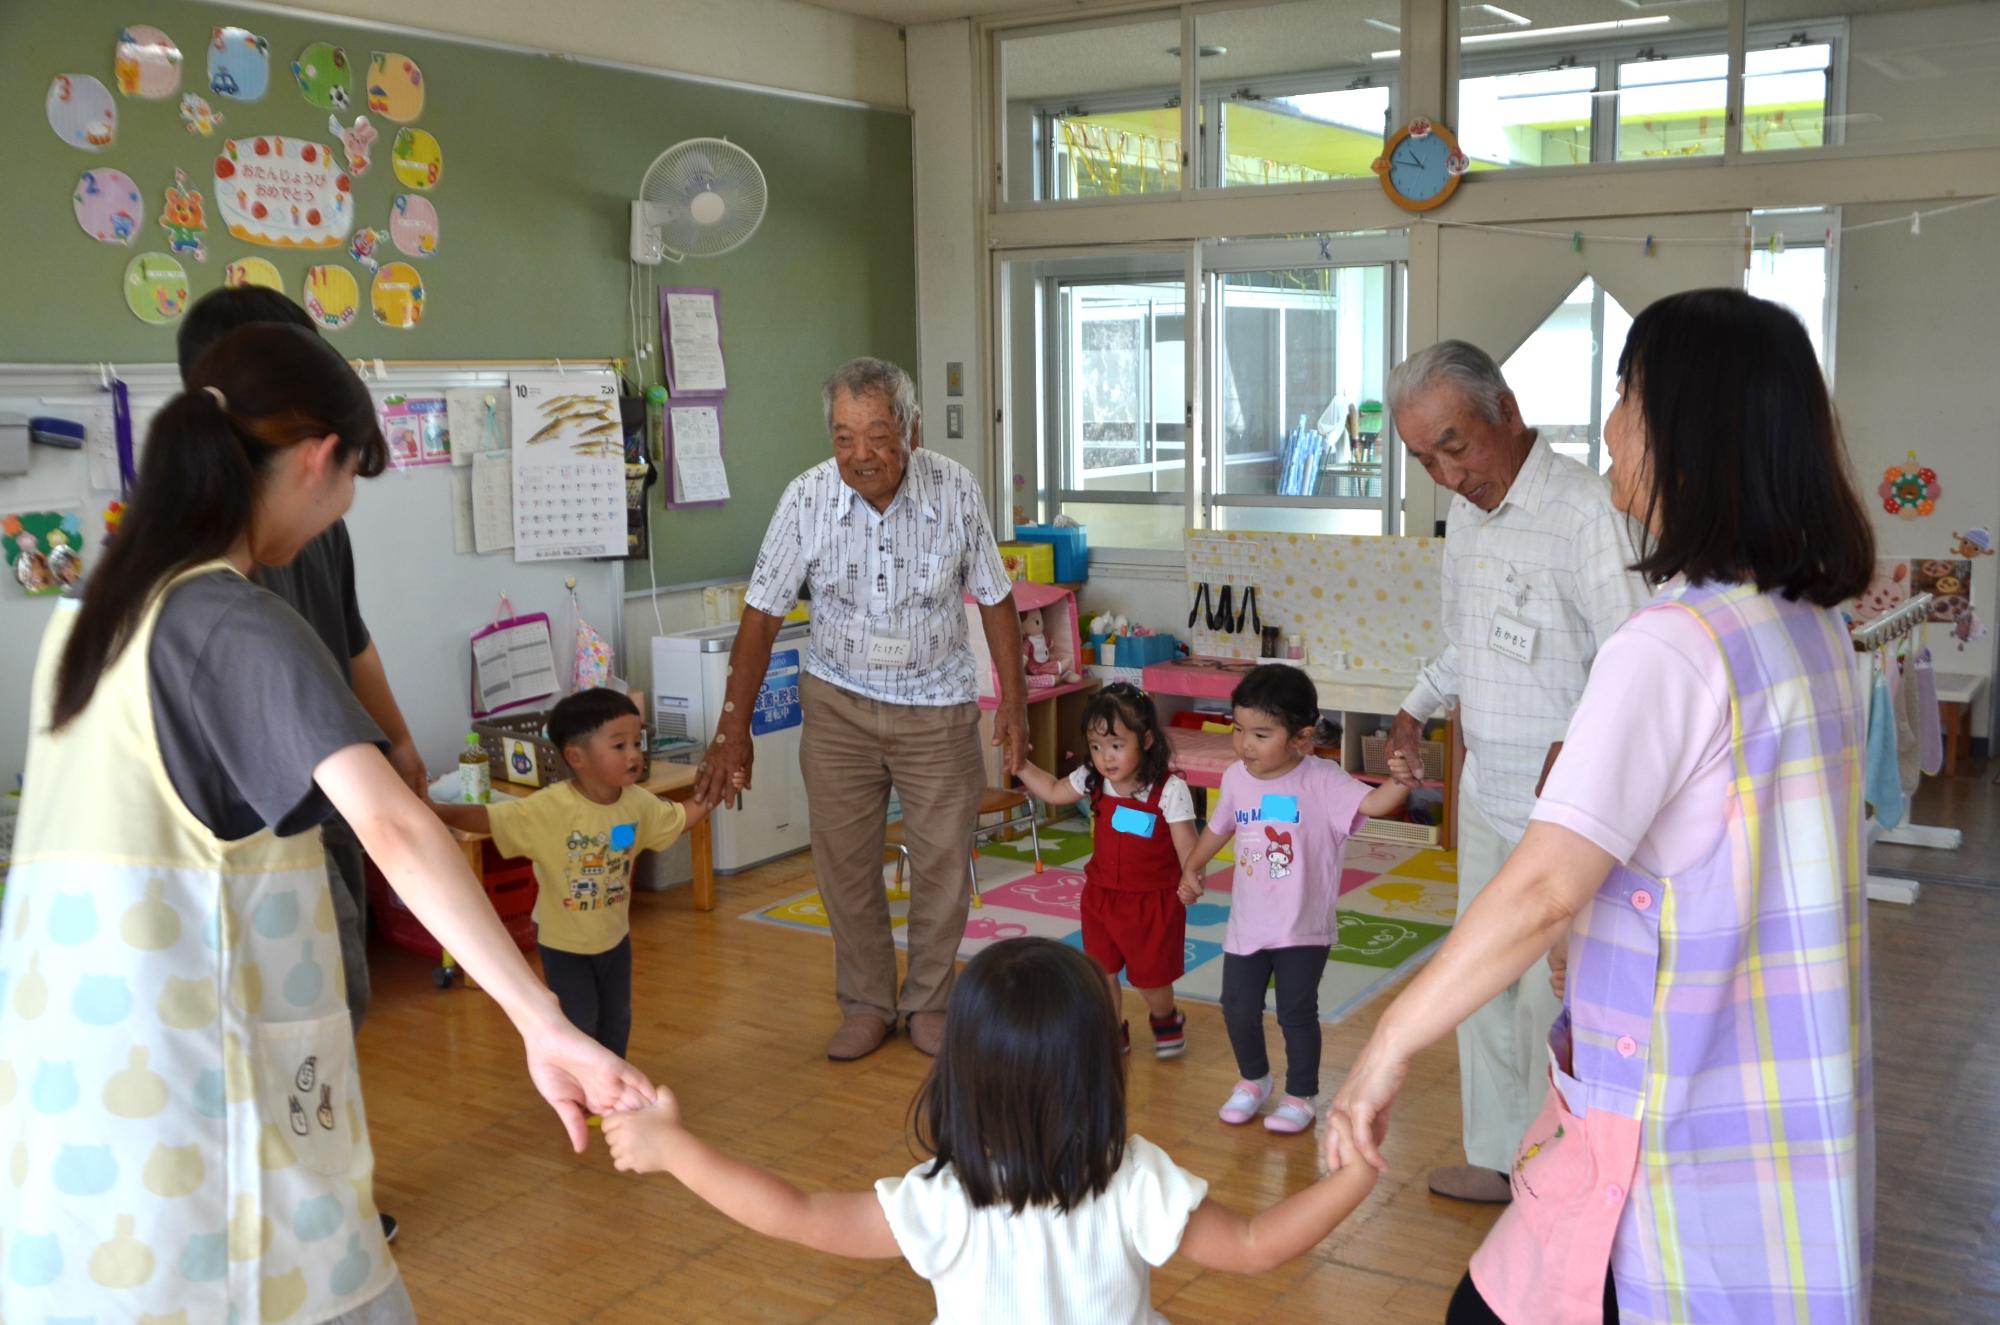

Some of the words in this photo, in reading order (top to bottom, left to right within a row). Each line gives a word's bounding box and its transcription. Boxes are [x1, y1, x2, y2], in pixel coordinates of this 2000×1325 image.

[370, 51, 385, 74] 7
[56, 74, 72, 102] 3
[81, 172, 99, 194] 2
[428, 161, 439, 184] 8
[255, 183, 315, 202] おめでとう
[395, 194, 407, 216] 9
[310, 266, 327, 287] 11
[515, 384, 528, 398] 10
[1494, 626, 1527, 648] おかもと
[765, 706, 790, 722] 運転中
[1235, 809, 1249, 825] My
